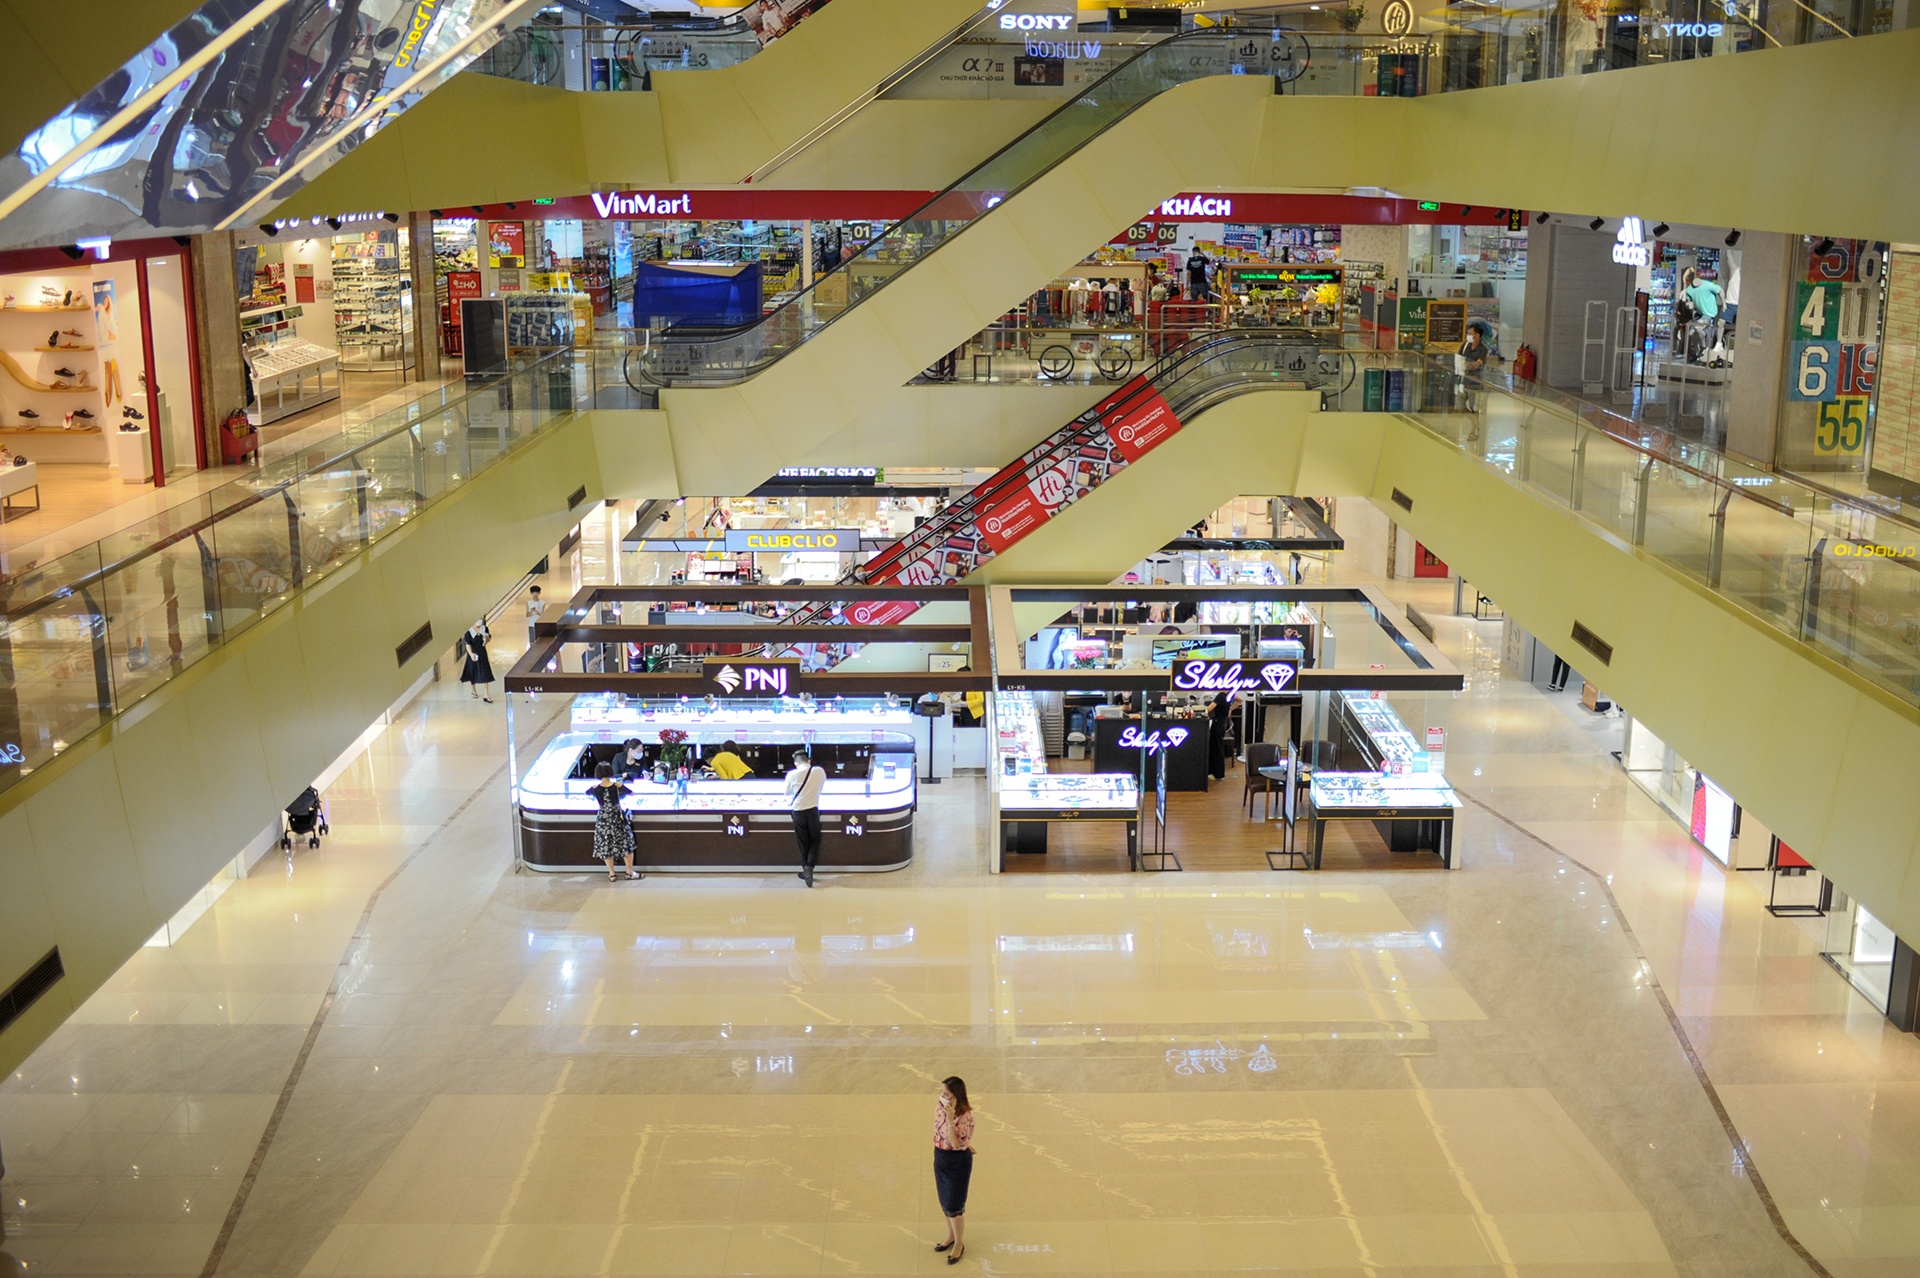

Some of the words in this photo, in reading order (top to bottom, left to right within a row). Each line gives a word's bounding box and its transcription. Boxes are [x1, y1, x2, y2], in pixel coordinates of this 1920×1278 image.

[1000, 14, 1073, 30] SONY
[591, 191, 692, 219] VinMart
[1161, 194, 1231, 216] KHÁCH
[853, 225, 870, 238] 01
[1127, 225, 1147, 240] 05
[1158, 225, 1176, 240] 06
[1613, 241, 1649, 266] adidas
[1800, 286, 1825, 337] 4
[1841, 287, 1869, 339] 11
[1799, 345, 1829, 397] 6
[1841, 344, 1877, 393] 19
[1817, 400, 1863, 451] 55
[1040, 475, 1063, 502] Hi
[748, 534, 837, 548] CLUBCLIO
[744, 668, 788, 695] PNJ
[1175, 660, 1261, 702] Sherlyn
[728, 826, 743, 836] PNJ
[846, 826, 862, 836] PNJ
